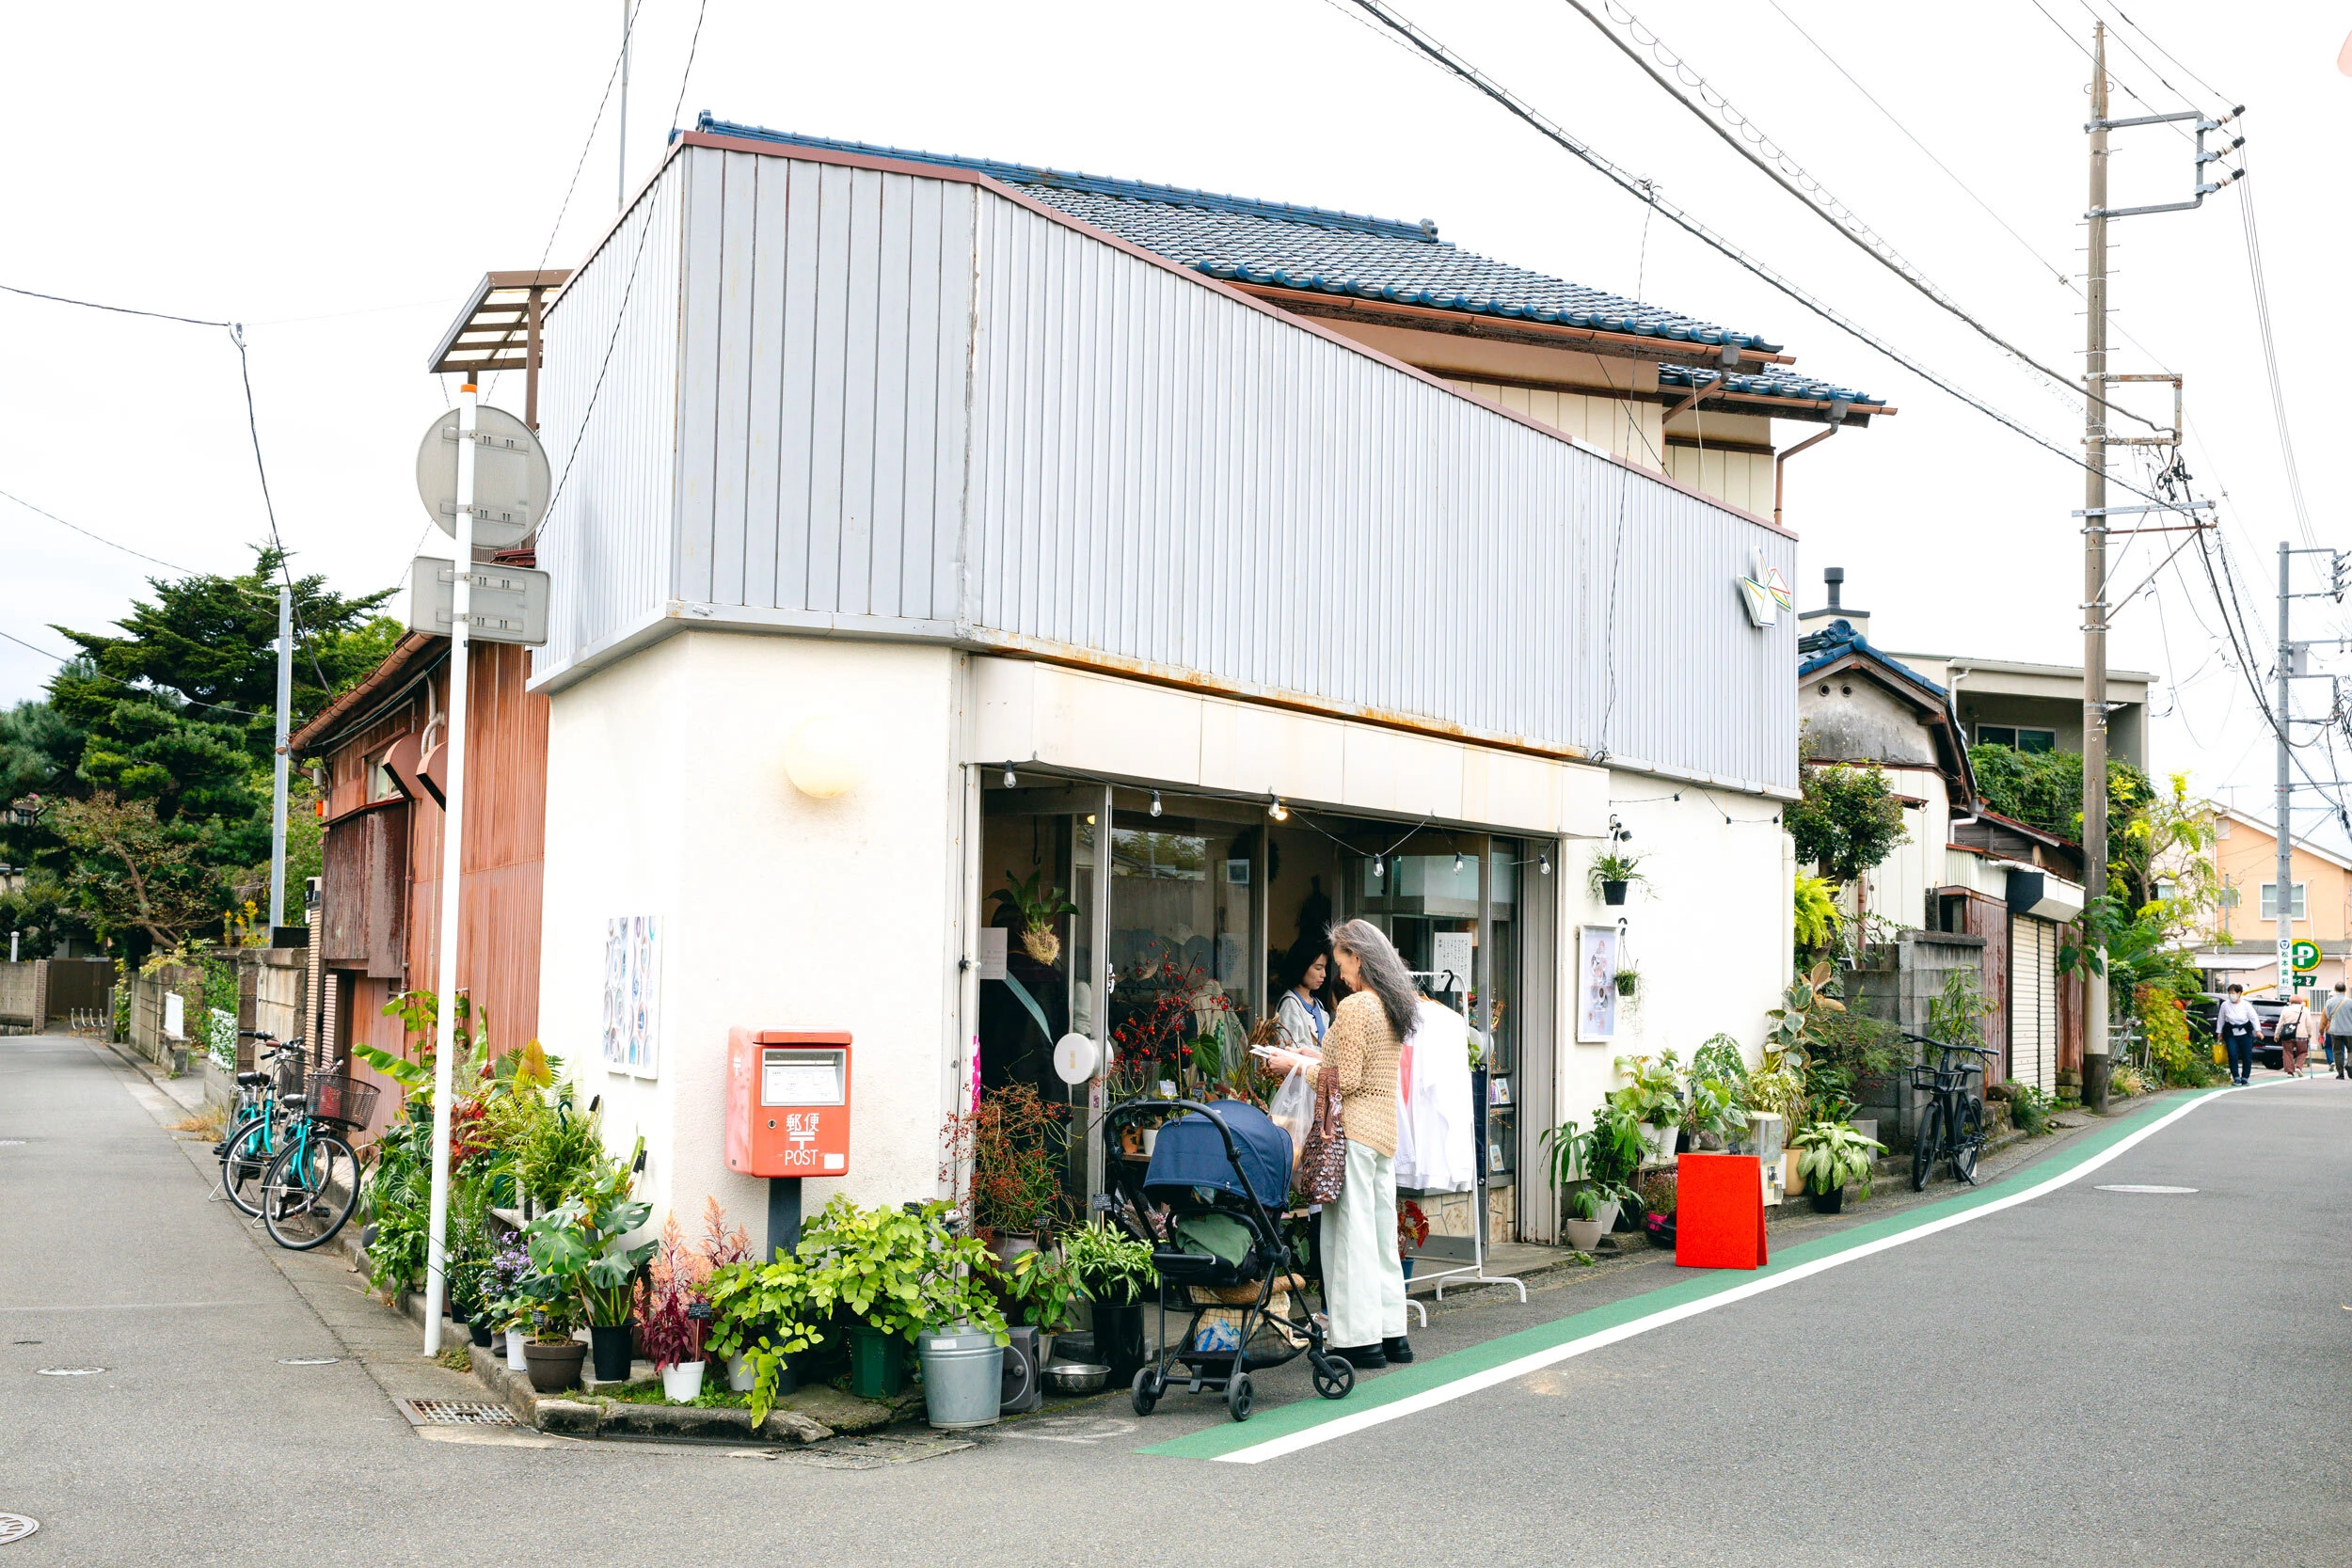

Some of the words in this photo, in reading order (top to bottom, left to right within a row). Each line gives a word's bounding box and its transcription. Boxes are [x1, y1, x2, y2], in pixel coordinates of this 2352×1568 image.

[2297, 945, 2314, 966] P
[786, 1113, 819, 1132] 郵便
[785, 1148, 818, 1166] POST
